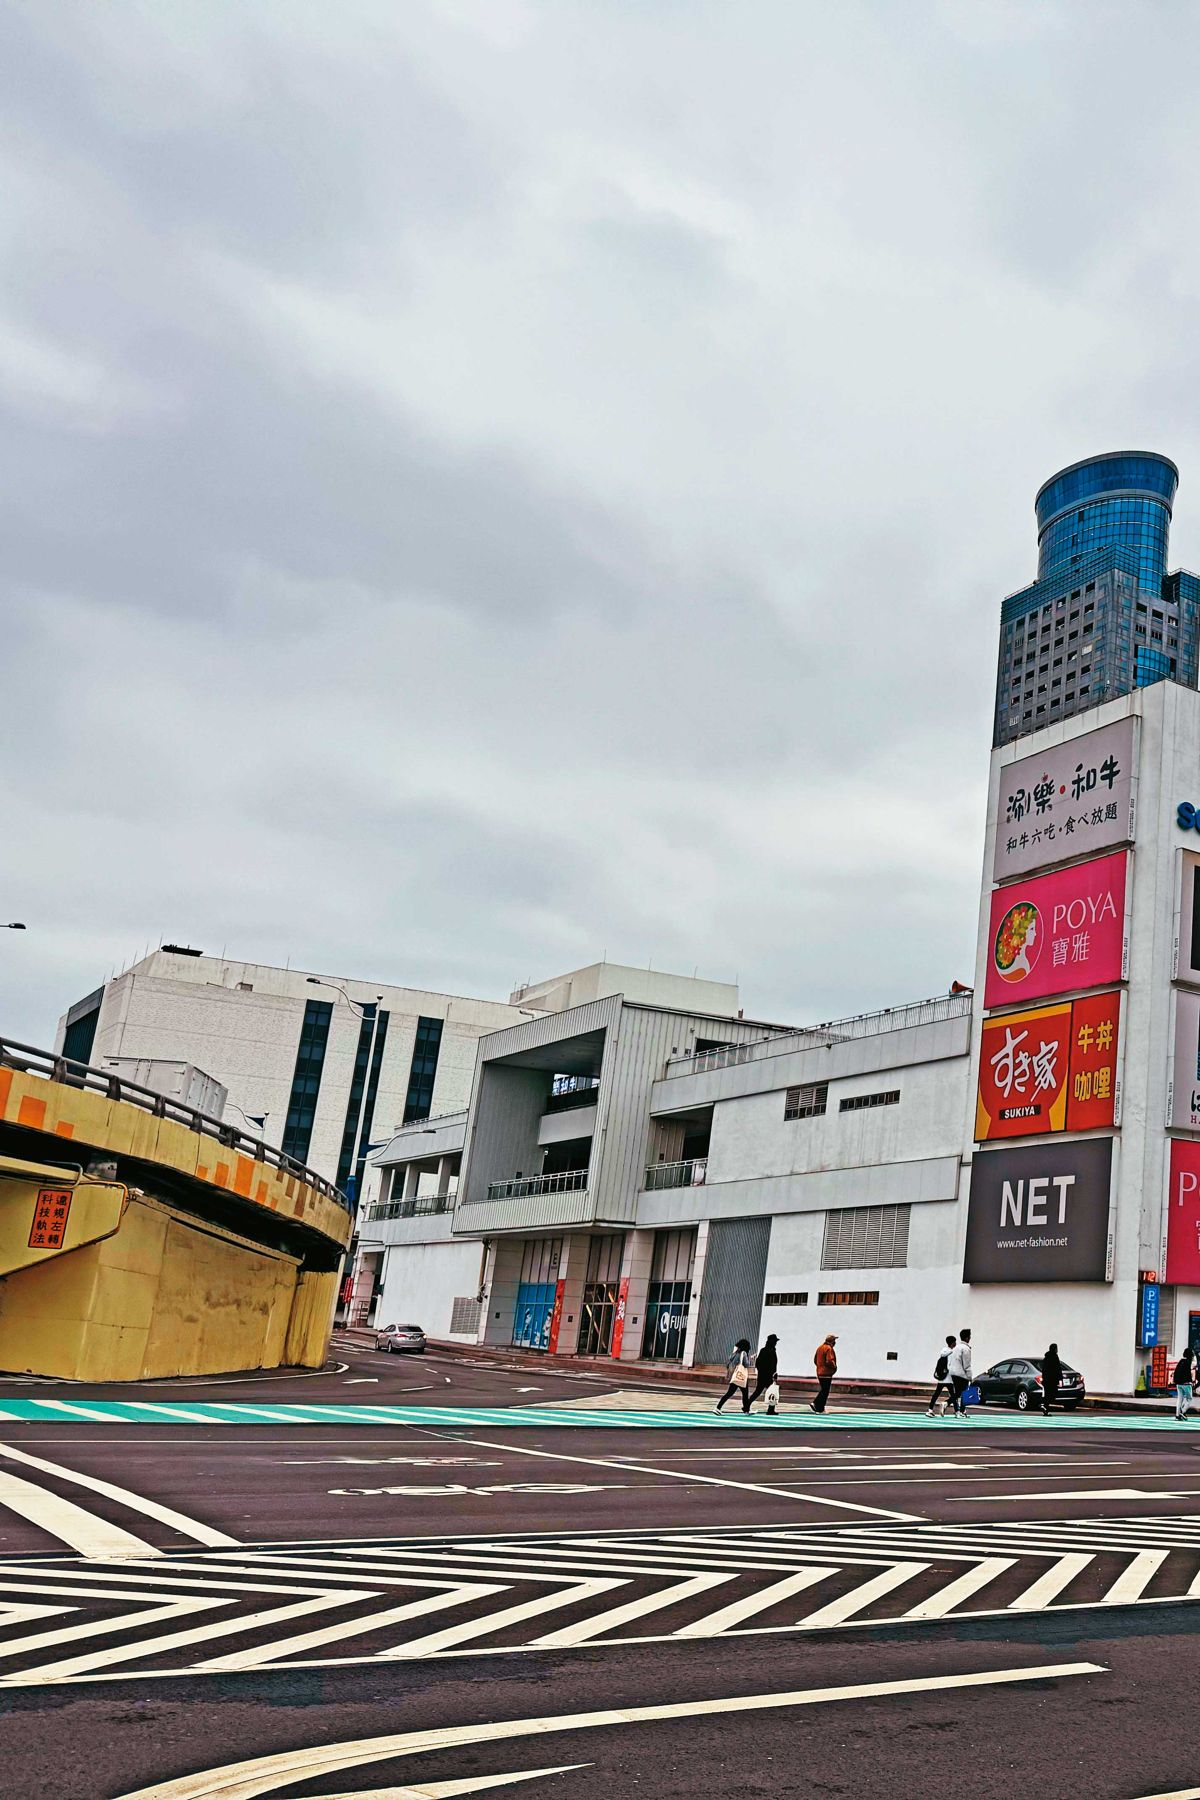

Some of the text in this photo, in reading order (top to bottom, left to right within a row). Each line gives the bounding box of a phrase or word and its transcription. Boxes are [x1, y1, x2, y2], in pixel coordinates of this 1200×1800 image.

[1053, 891, 1117, 934] POYA
[1052, 931, 1090, 967] 寶雅
[1077, 1021, 1113, 1054] 牛丼
[990, 1027, 1059, 1102] すき家
[1074, 1066, 1111, 1102] 咖哩
[1004, 1105, 1035, 1119] SUKIYA
[1000, 1175, 1076, 1227] NET
[997, 1236, 1068, 1249] www.net-fashion.net
[1148, 1290, 1155, 1301] P
